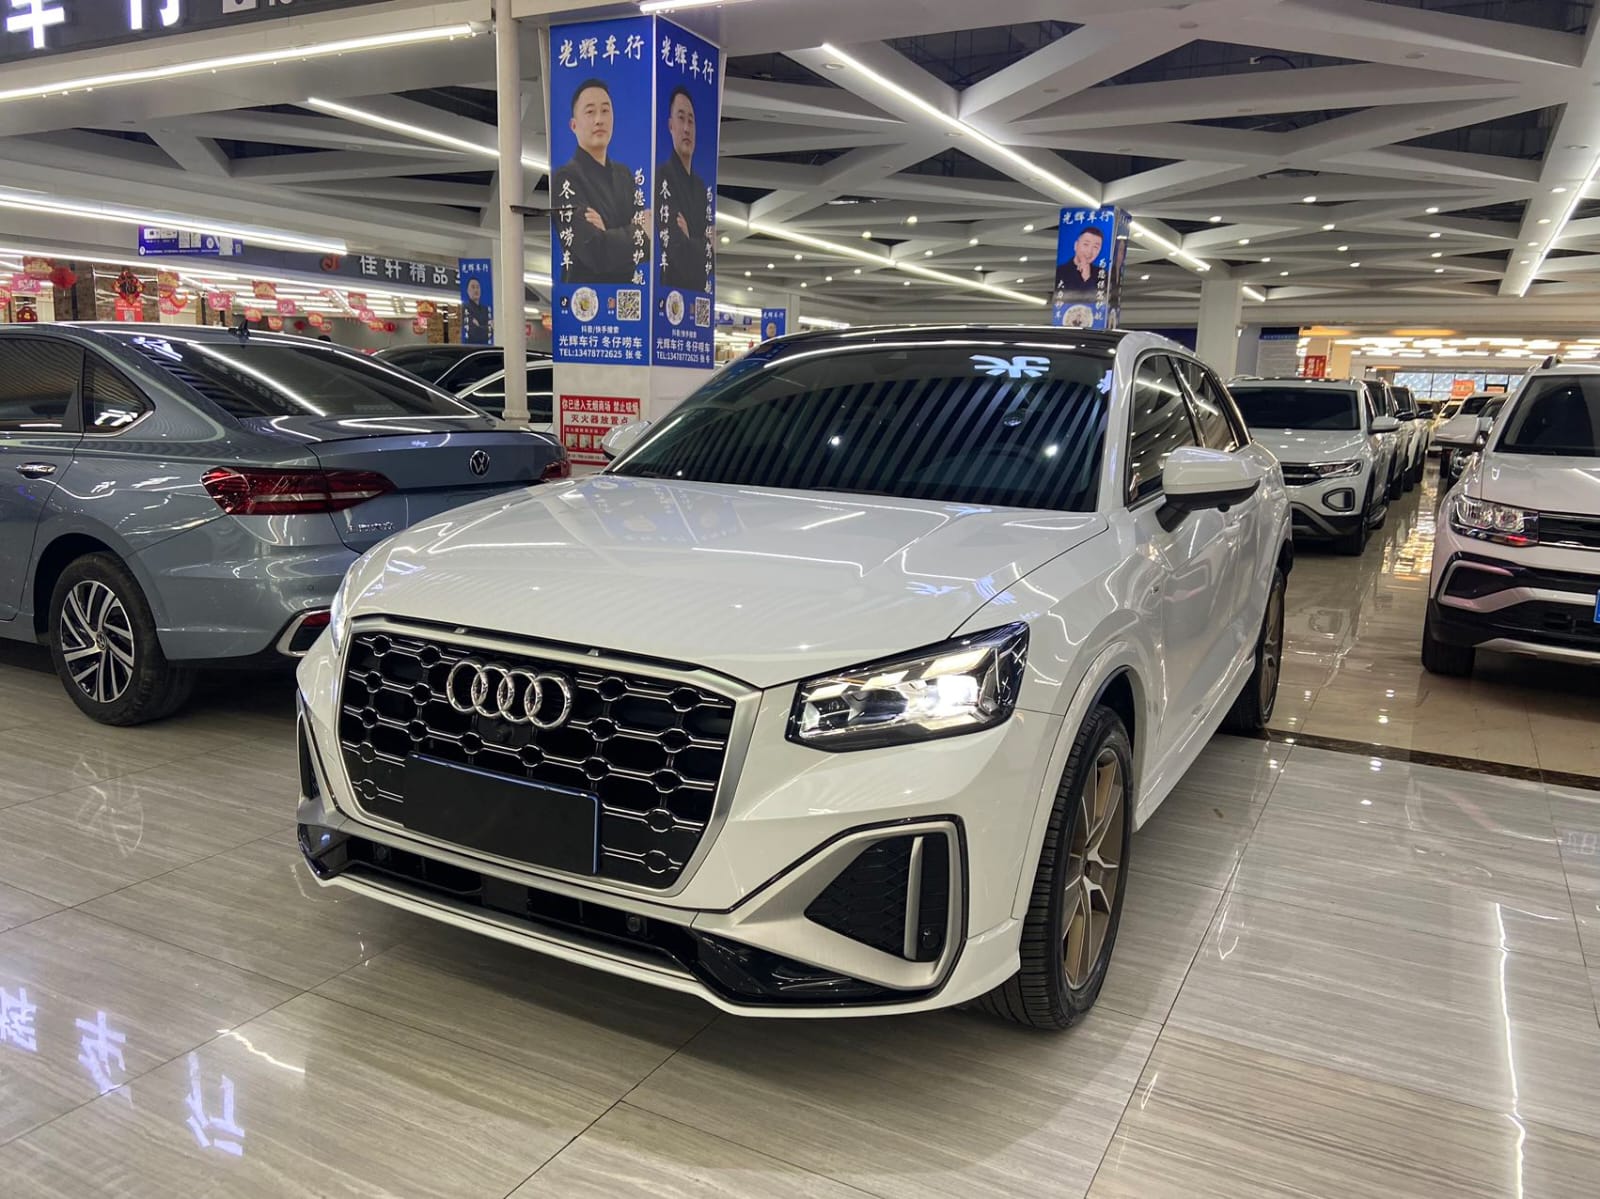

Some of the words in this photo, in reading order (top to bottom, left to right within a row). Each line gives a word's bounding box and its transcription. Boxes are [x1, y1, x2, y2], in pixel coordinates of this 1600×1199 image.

[558, 34, 645, 68] 光辉车行
[661, 35, 715, 85] 光辉车行
[631, 168, 646, 285] 为您保驾护航
[359, 255, 461, 285] 佳轩精品
[559, 334, 599, 348] 光辉车行
[601, 336, 643, 349] 冬仔唠车
[559, 348, 623, 359] TEL:13478772625
[571, 414, 629, 425] 灭火器放置点
